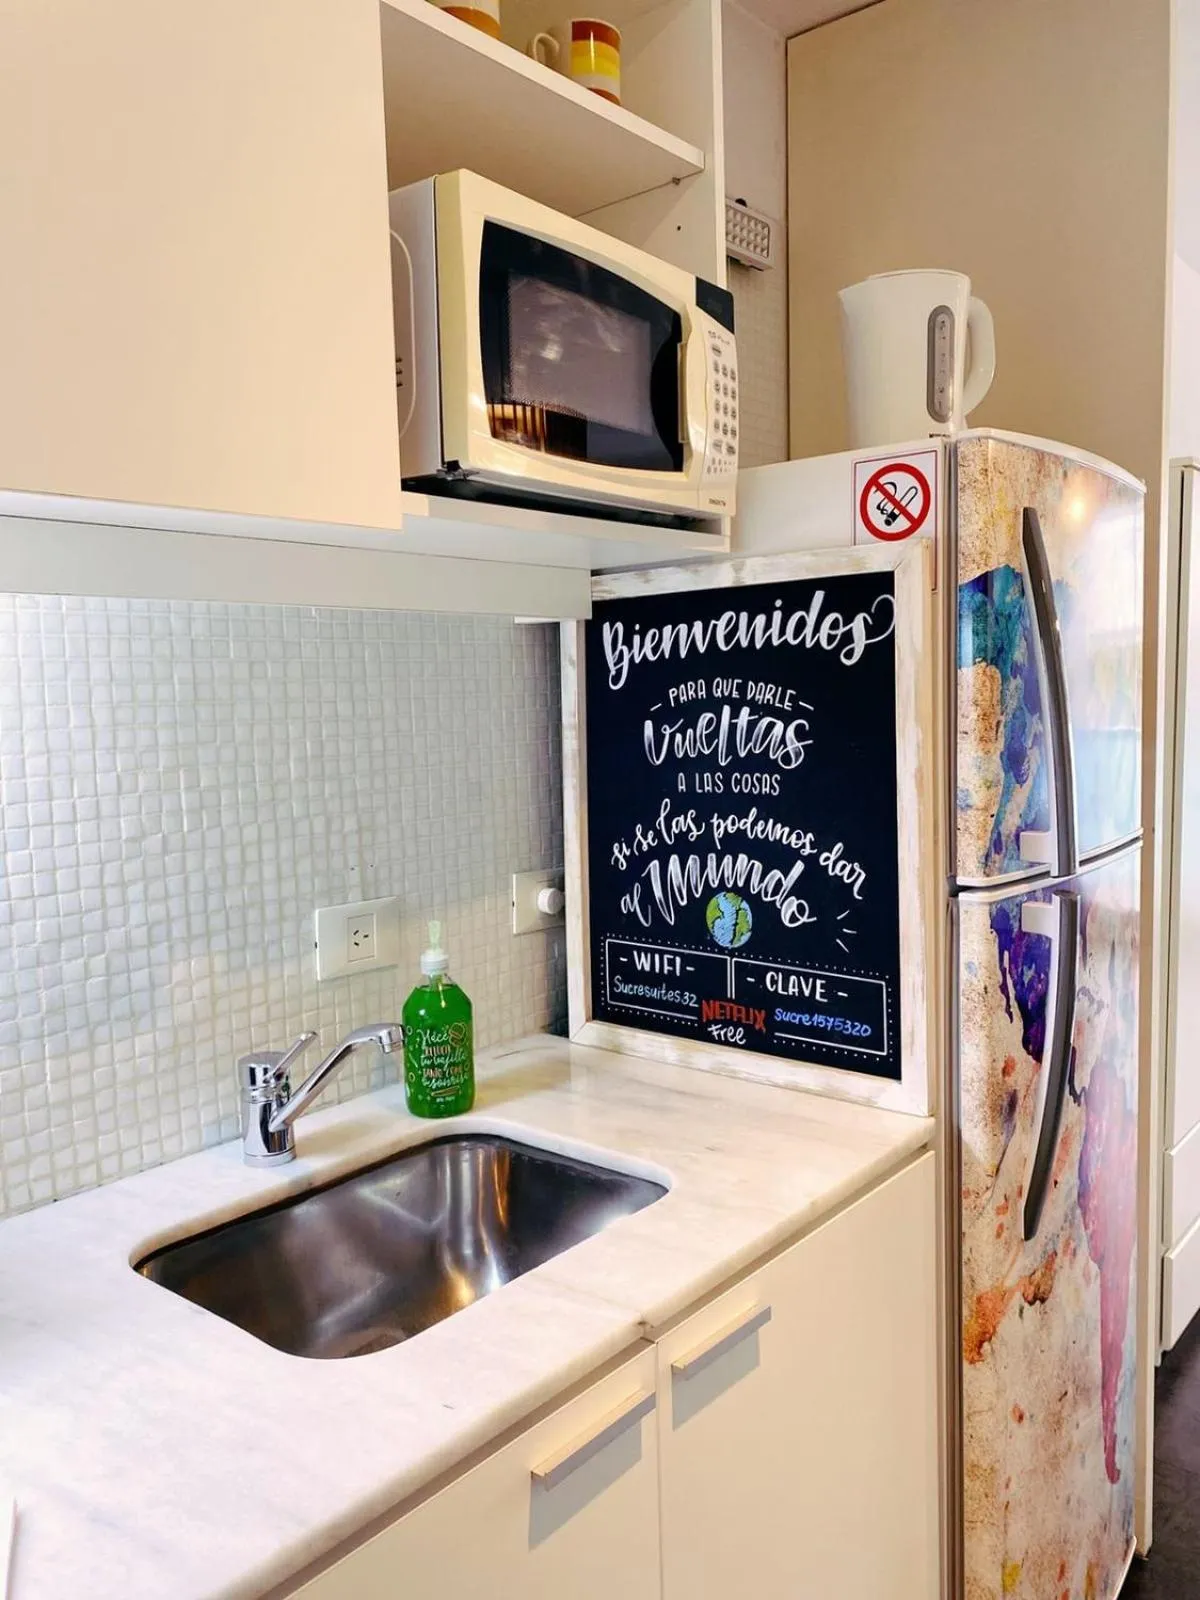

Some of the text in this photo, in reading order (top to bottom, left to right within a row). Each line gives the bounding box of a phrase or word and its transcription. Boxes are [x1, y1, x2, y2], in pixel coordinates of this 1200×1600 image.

[602, 590, 896, 690] Bienvenidos
[669, 677, 796, 711] PARA QUE DARLE
[678, 773, 781, 796] A LAS COSAS
[611, 798, 867, 900] si se las podemos dar
[620, 882, 652, 928] al
[633, 950, 682, 977] WIFI
[765, 971, 828, 1003] CLAVE
[701, 998, 767, 1033] NETFLIX
[707, 1023, 747, 1045] Free
